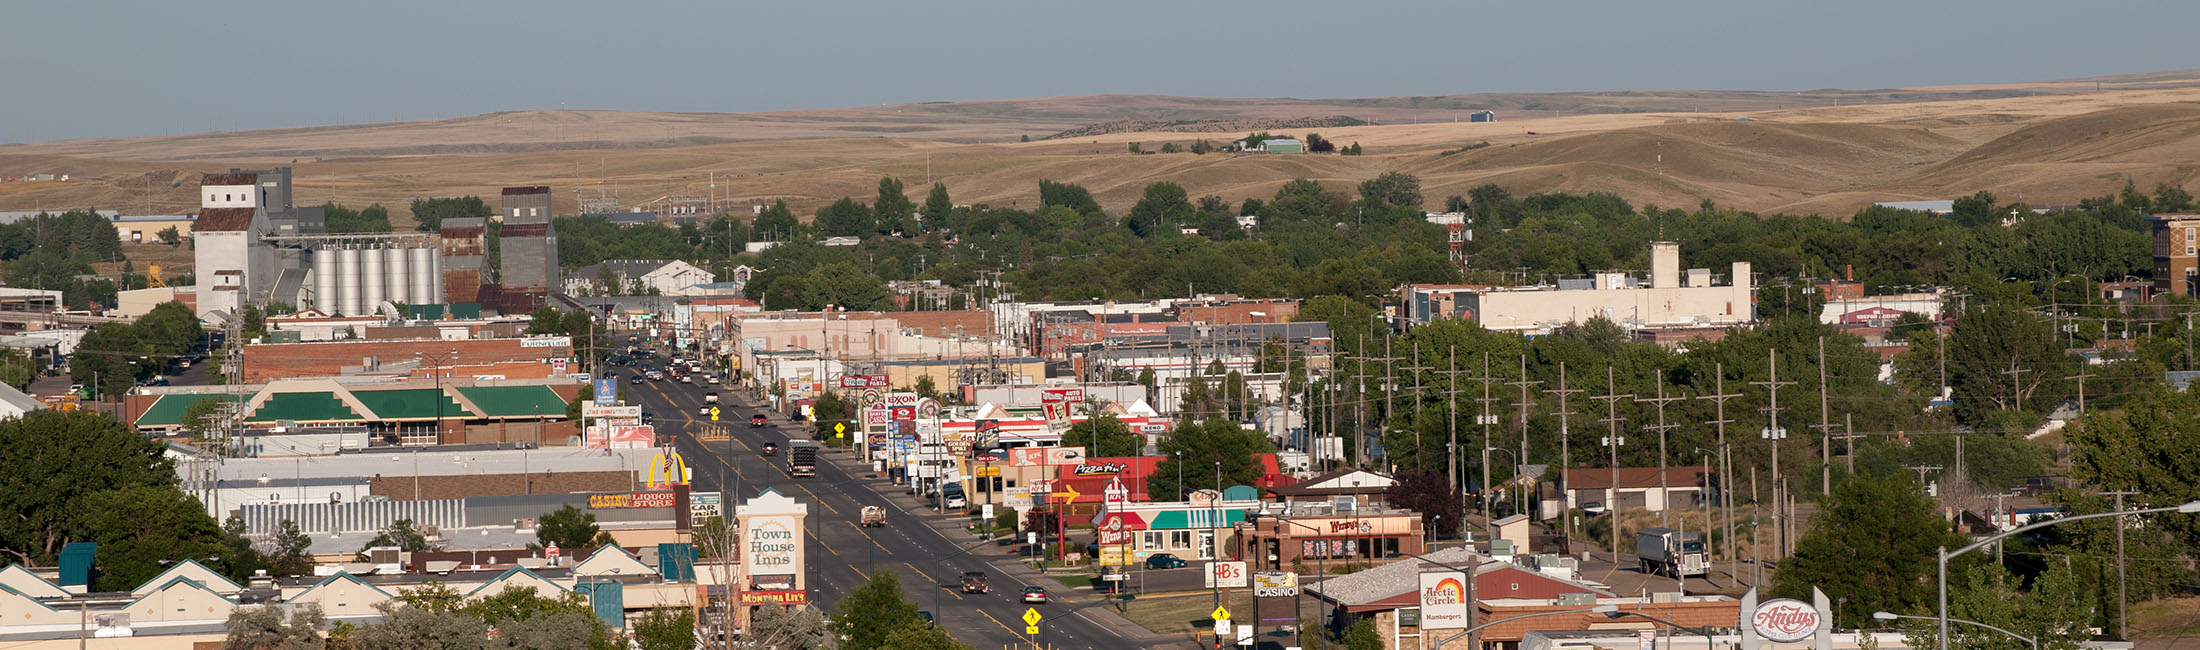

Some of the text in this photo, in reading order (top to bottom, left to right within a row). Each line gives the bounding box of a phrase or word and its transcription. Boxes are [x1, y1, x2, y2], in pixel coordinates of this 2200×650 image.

[888, 395, 915, 405] EXXON
[1074, 463, 1104, 474] Pizza
[590, 494, 628, 507] CASINO
[633, 499, 673, 507] STORE
[752, 528, 792, 540] Town
[751, 541, 795, 552] House
[755, 554, 790, 565] Inns
[1258, 588, 1295, 597] CASINO
[1424, 587, 1456, 599] Arctic
[1426, 596, 1456, 606] Circle
[1755, 605, 1816, 633] Andys
